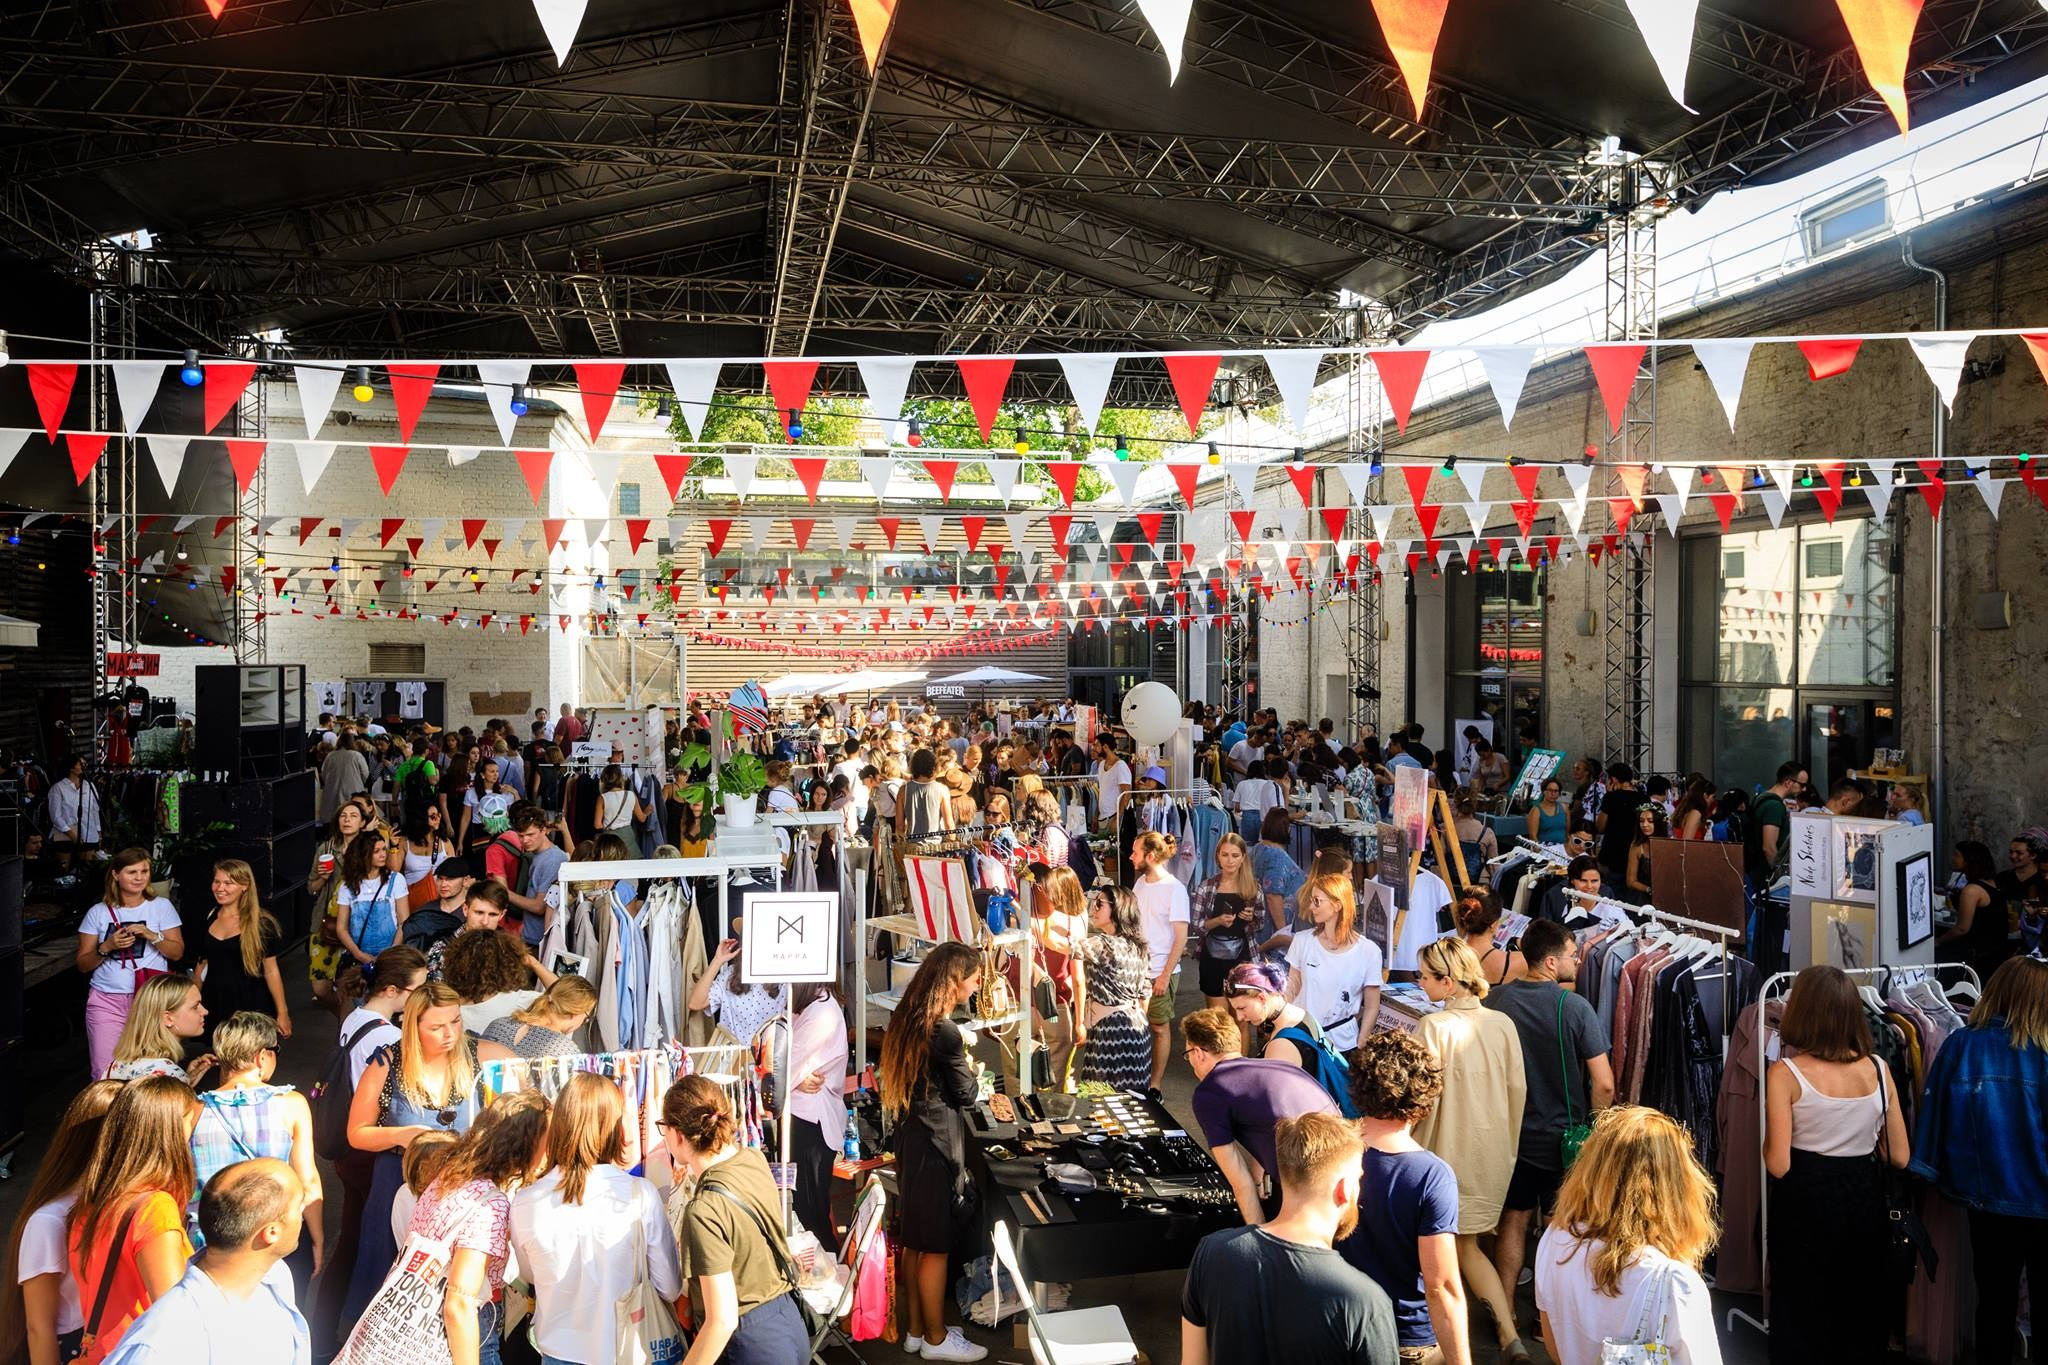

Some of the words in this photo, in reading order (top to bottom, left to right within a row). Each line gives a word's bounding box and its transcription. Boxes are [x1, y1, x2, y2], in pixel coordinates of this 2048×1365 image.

[927, 685, 965, 697] BEEFEATER
[380, 1287, 416, 1320] PARIS
[394, 1271, 431, 1308] TOKYO
[365, 1312, 382, 1329] SEOUL
[381, 1326, 401, 1343] HONG
[401, 1339, 422, 1353] KONG
[372, 1302, 400, 1328] BERLIN
[398, 1322, 434, 1348] BEIJING
